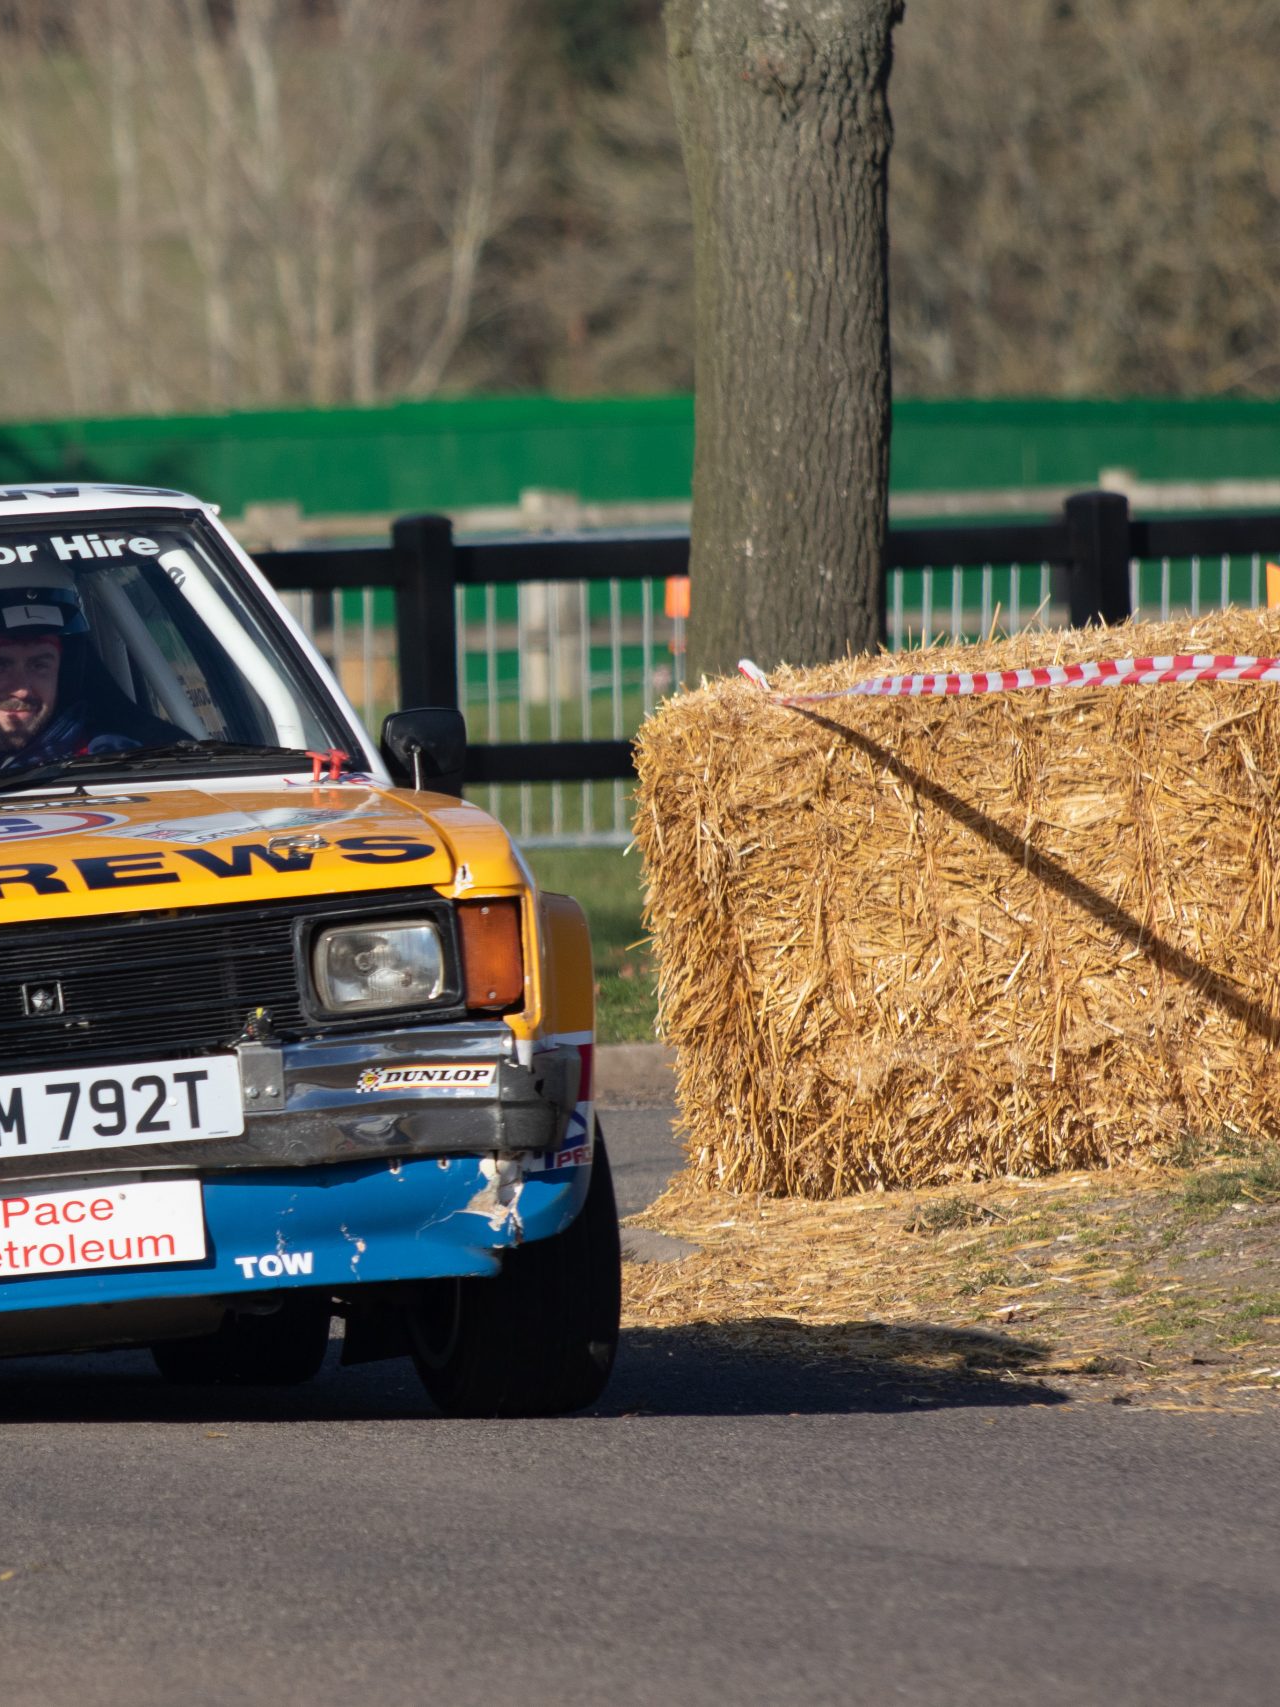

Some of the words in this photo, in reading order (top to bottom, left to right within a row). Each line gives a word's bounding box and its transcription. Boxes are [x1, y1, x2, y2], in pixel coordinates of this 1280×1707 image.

[50, 534, 160, 561] Hire
[383, 1069, 490, 1083] DUNLOP
[45, 1070, 209, 1141] 792T
[1, 1196, 114, 1229] Pace
[235, 1250, 314, 1279] TOW
